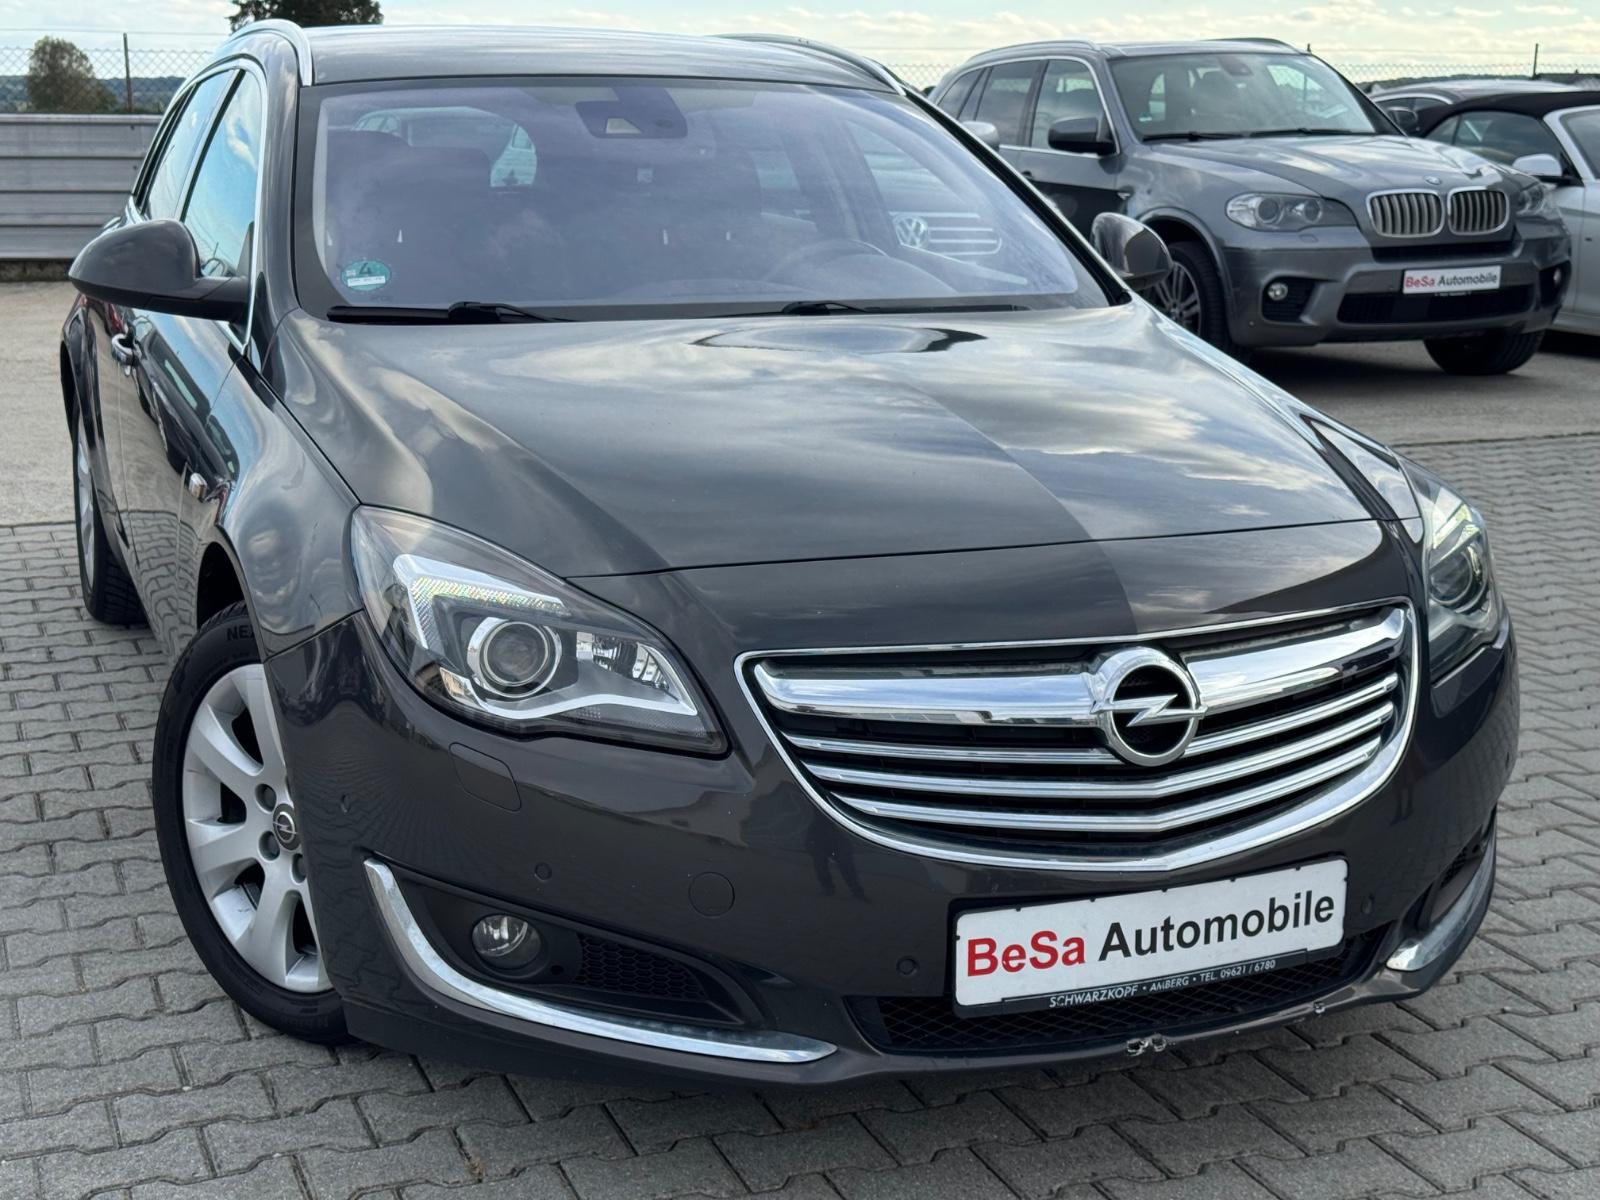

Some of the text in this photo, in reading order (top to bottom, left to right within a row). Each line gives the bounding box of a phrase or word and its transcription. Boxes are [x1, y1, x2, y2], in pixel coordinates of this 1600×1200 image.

[1405, 272, 1497, 288] BeSa Automobile
[967, 890, 1334, 977] BeSa Automobile
[1049, 985, 1138, 1008] SCHWARZKOPF
[1149, 976, 1189, 991] AMBERG
